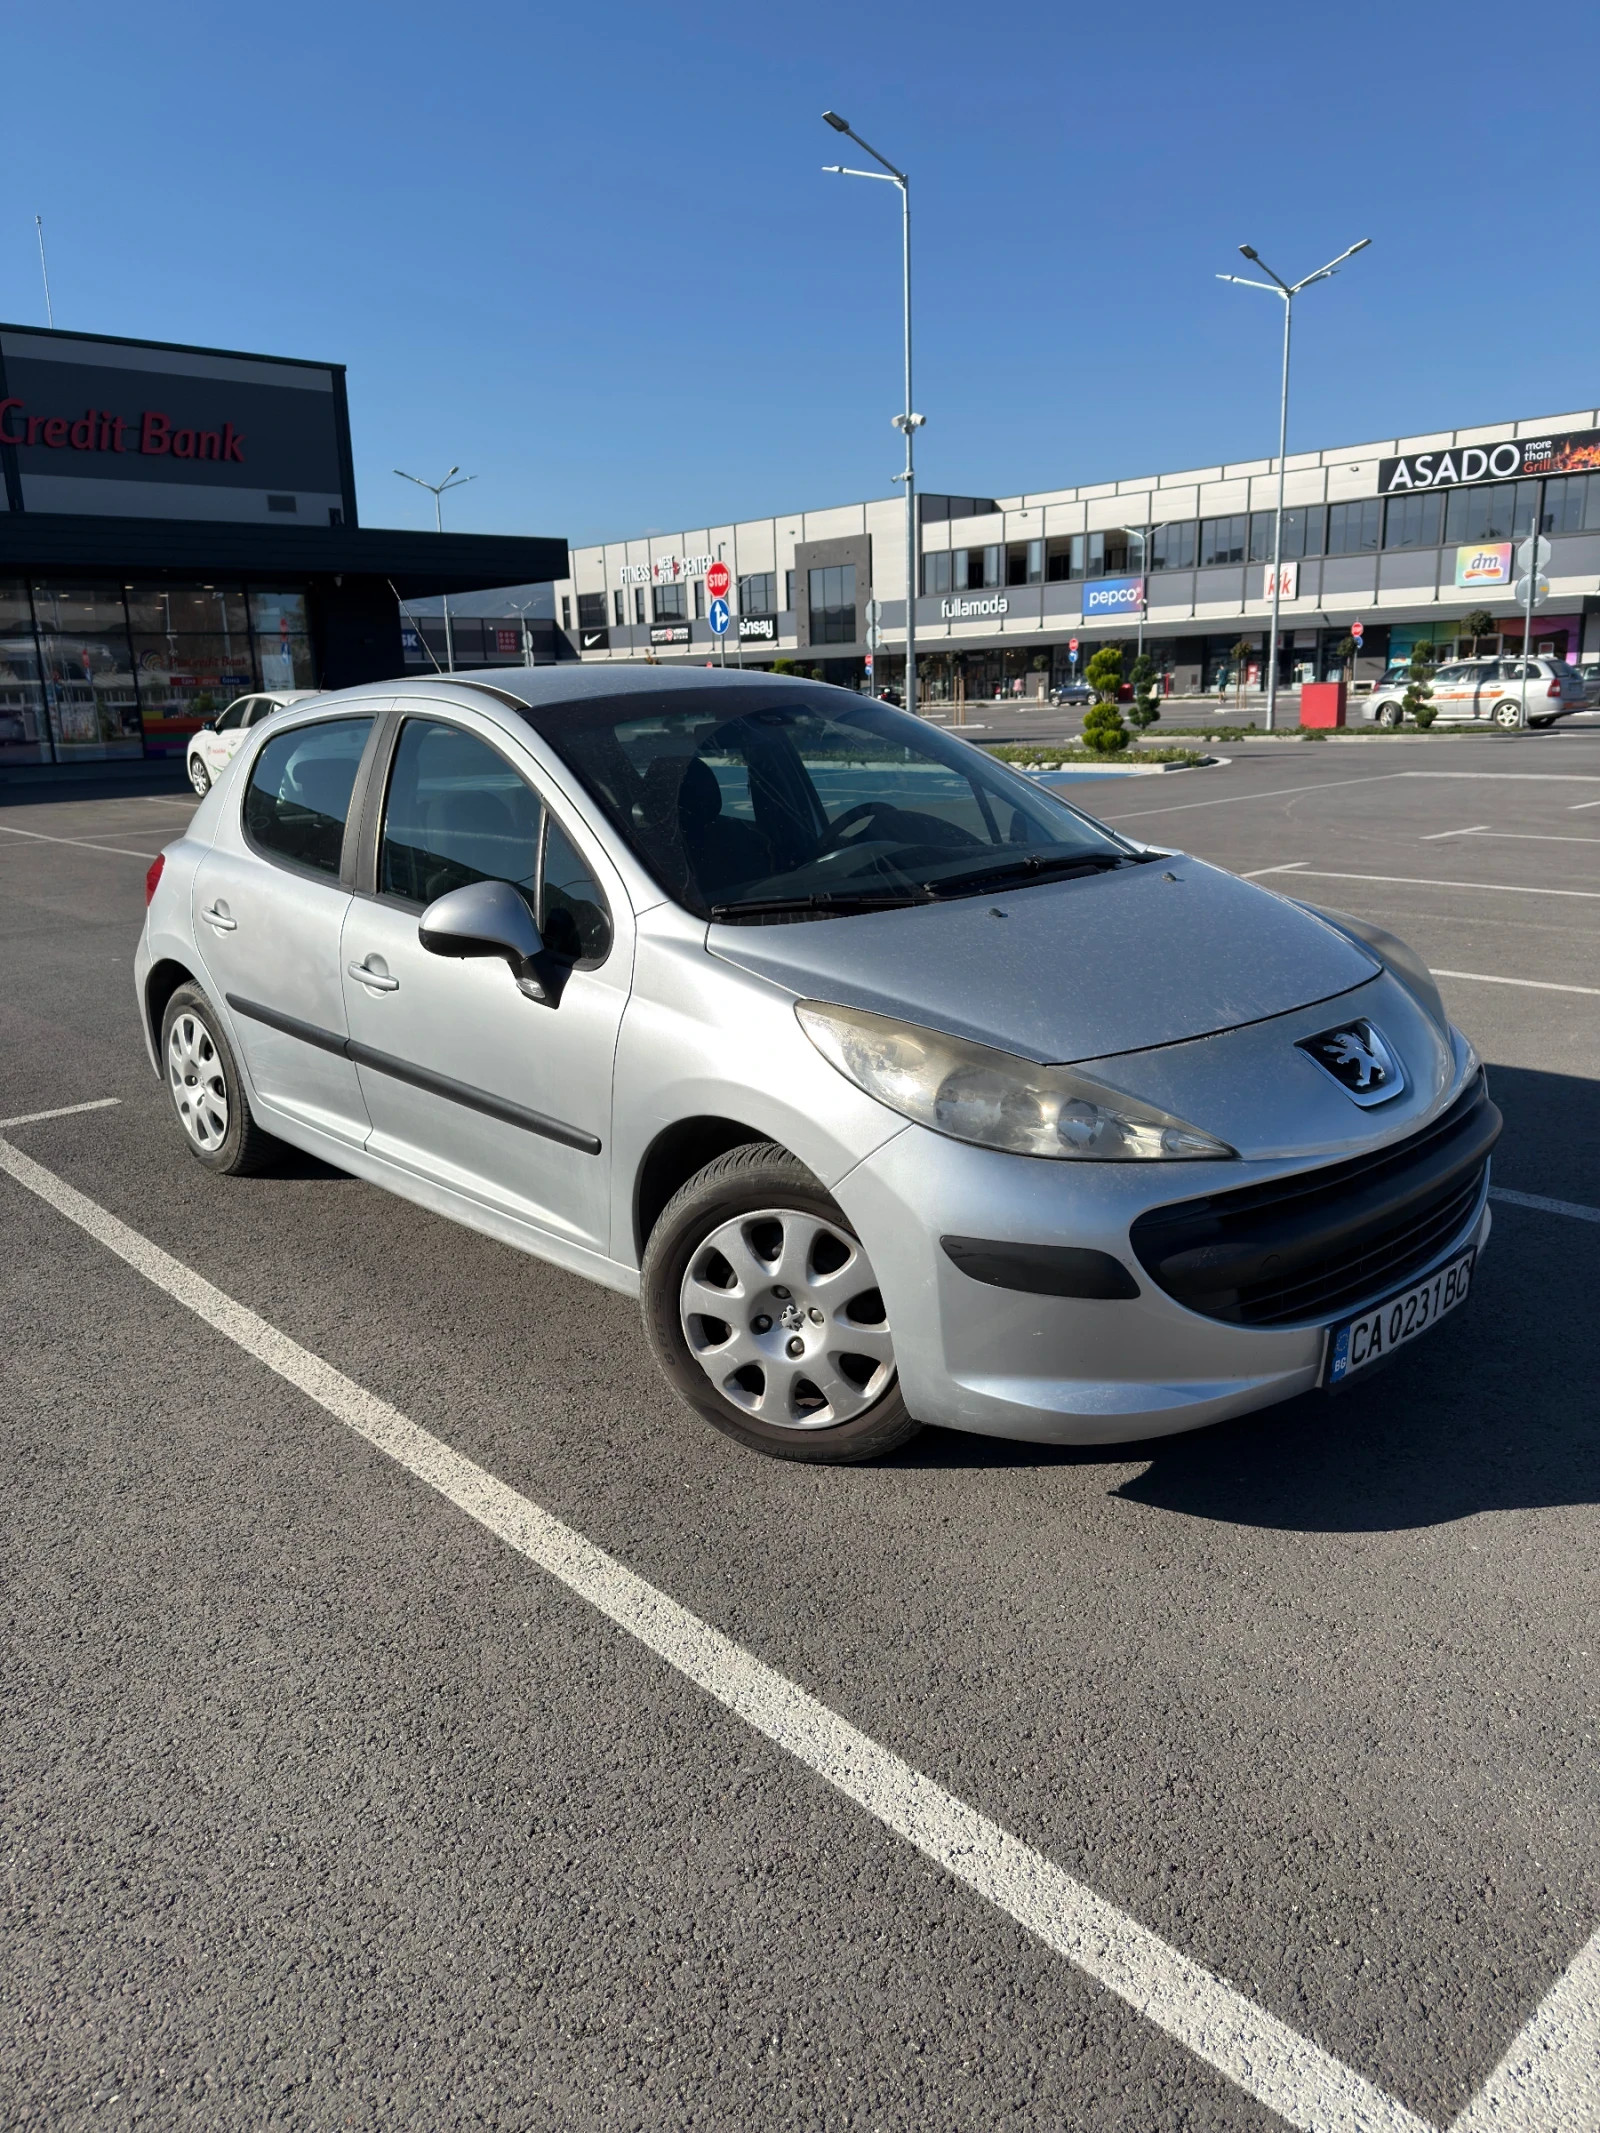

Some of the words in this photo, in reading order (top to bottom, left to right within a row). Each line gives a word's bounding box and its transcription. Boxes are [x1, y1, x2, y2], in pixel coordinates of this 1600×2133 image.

[0, 397, 127, 453] Credit
[140, 410, 246, 462] Bank
[1525, 440, 1552, 451] more
[1524, 450, 1551, 461] than
[1388, 443, 1520, 491] ASADO
[1523, 459, 1551, 473] Grill
[620, 563, 651, 584] FITNESS
[681, 555, 713, 576] CENTER
[656, 556, 674, 569] WEST
[1471, 552, 1499, 570] dm
[658, 568, 675, 583] GYM
[708, 573, 728, 588] STOP
[941, 594, 1008, 618] fullamoda
[1089, 588, 1137, 608] pepco
[739, 617, 773, 639] sinsay
[1351, 1314, 1382, 1365] CA
[1389, 1277, 1442, 1345] 0231
[1334, 1357, 1347, 1372] BG
